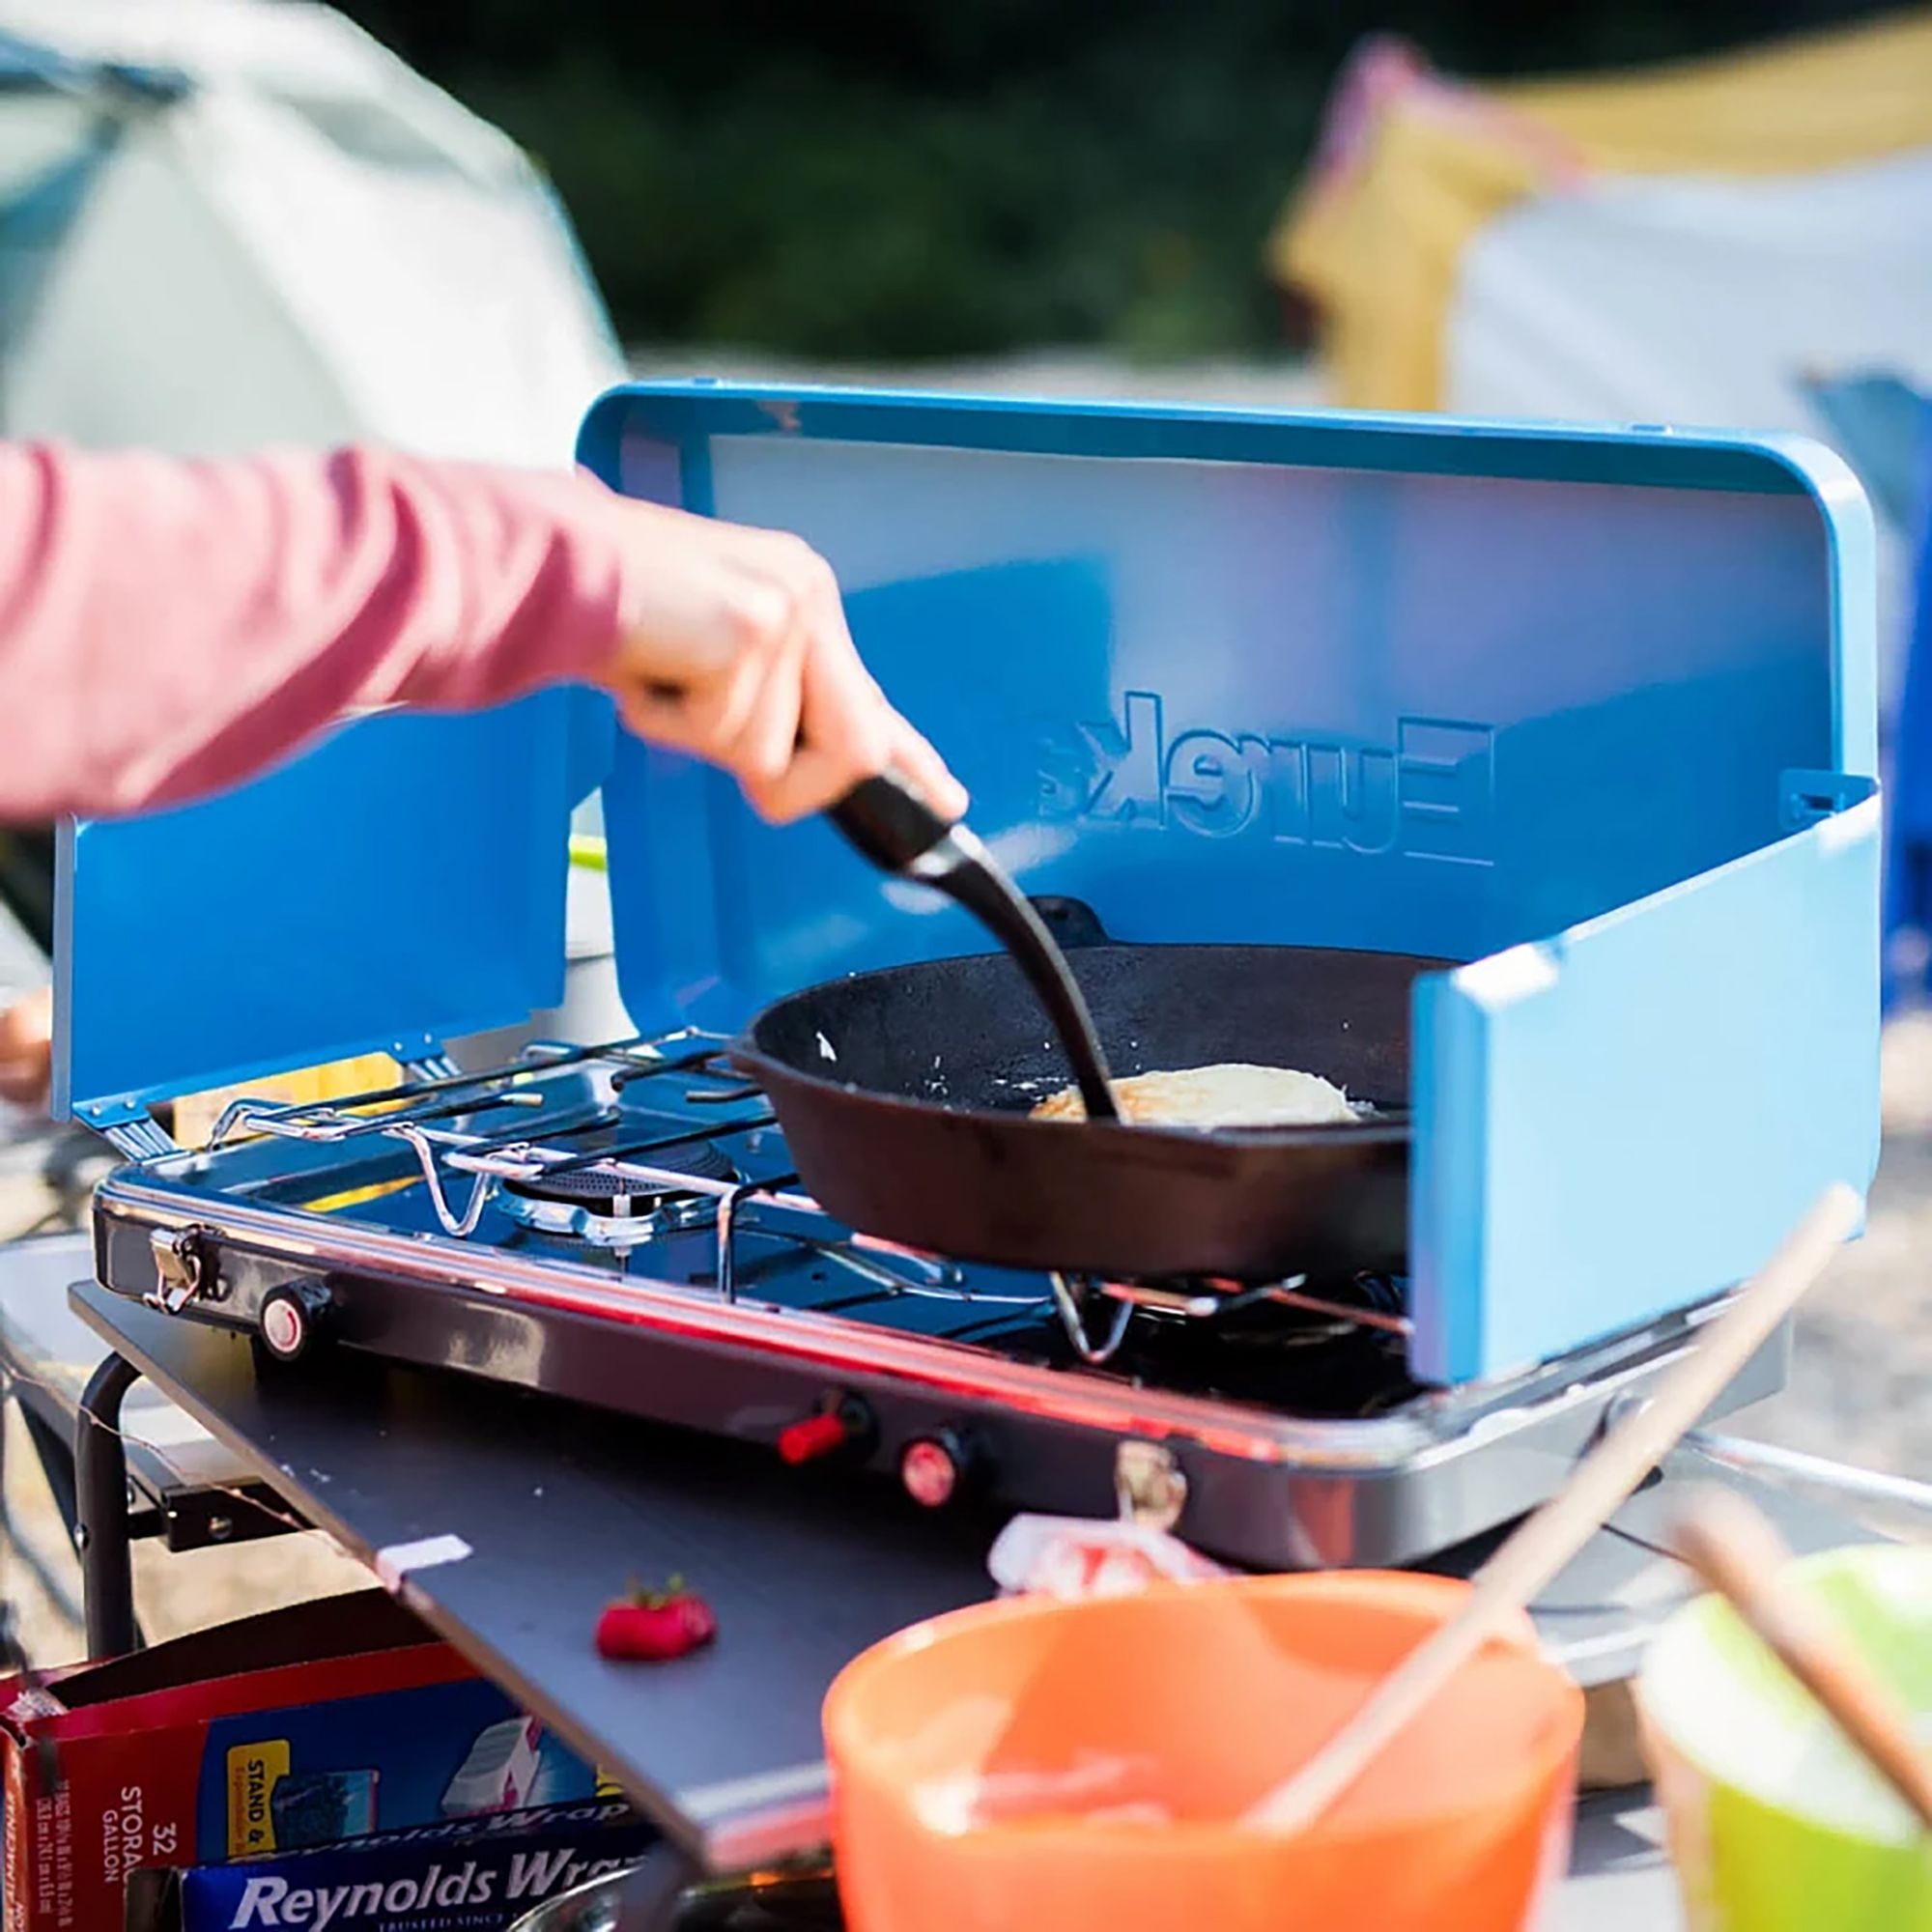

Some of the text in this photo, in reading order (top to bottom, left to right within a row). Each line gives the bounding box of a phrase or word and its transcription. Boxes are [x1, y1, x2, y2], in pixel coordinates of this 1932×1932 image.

[121, 1786, 143, 1885] STORA
[247, 1759, 265, 1843] STAND &
[488, 1803, 630, 1831] Wrap
[102, 1809, 120, 1883] GALLON
[153, 1822, 177, 1856] 32
[228, 1861, 497, 1932] Reynolds
